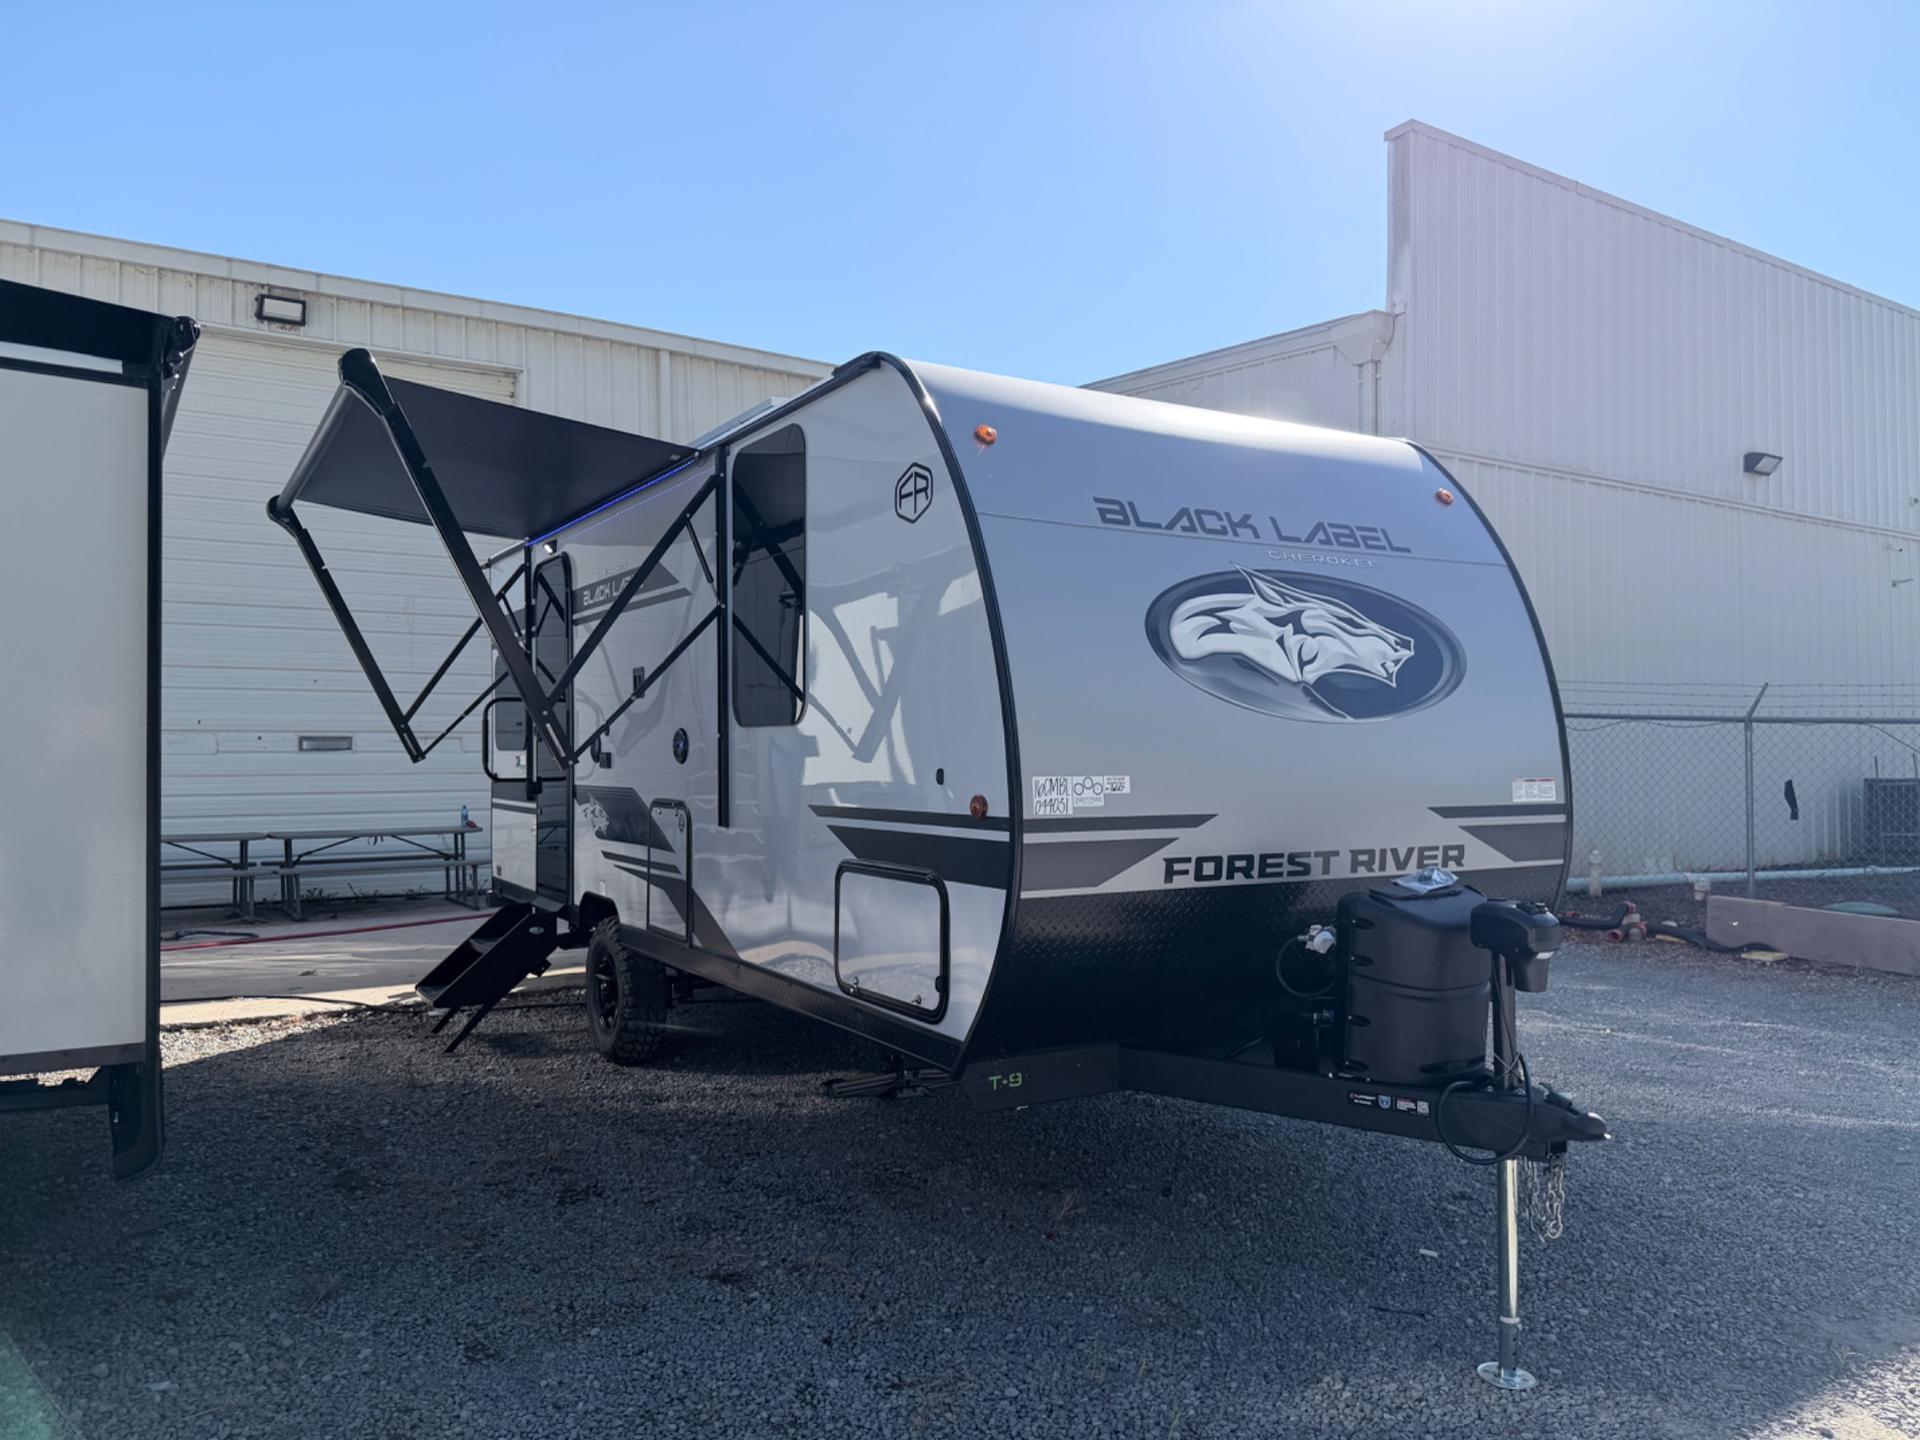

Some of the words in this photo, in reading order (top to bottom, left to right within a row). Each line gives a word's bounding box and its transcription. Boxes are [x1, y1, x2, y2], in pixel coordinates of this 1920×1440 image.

[1093, 496, 1261, 540] BLACK
[1269, 516, 1412, 554] LABEL
[1267, 549, 1382, 570] CHEROKEE
[583, 581, 611, 607] BLACK
[1163, 849, 1340, 884] FOREST
[1349, 844, 1466, 875] RIVER
